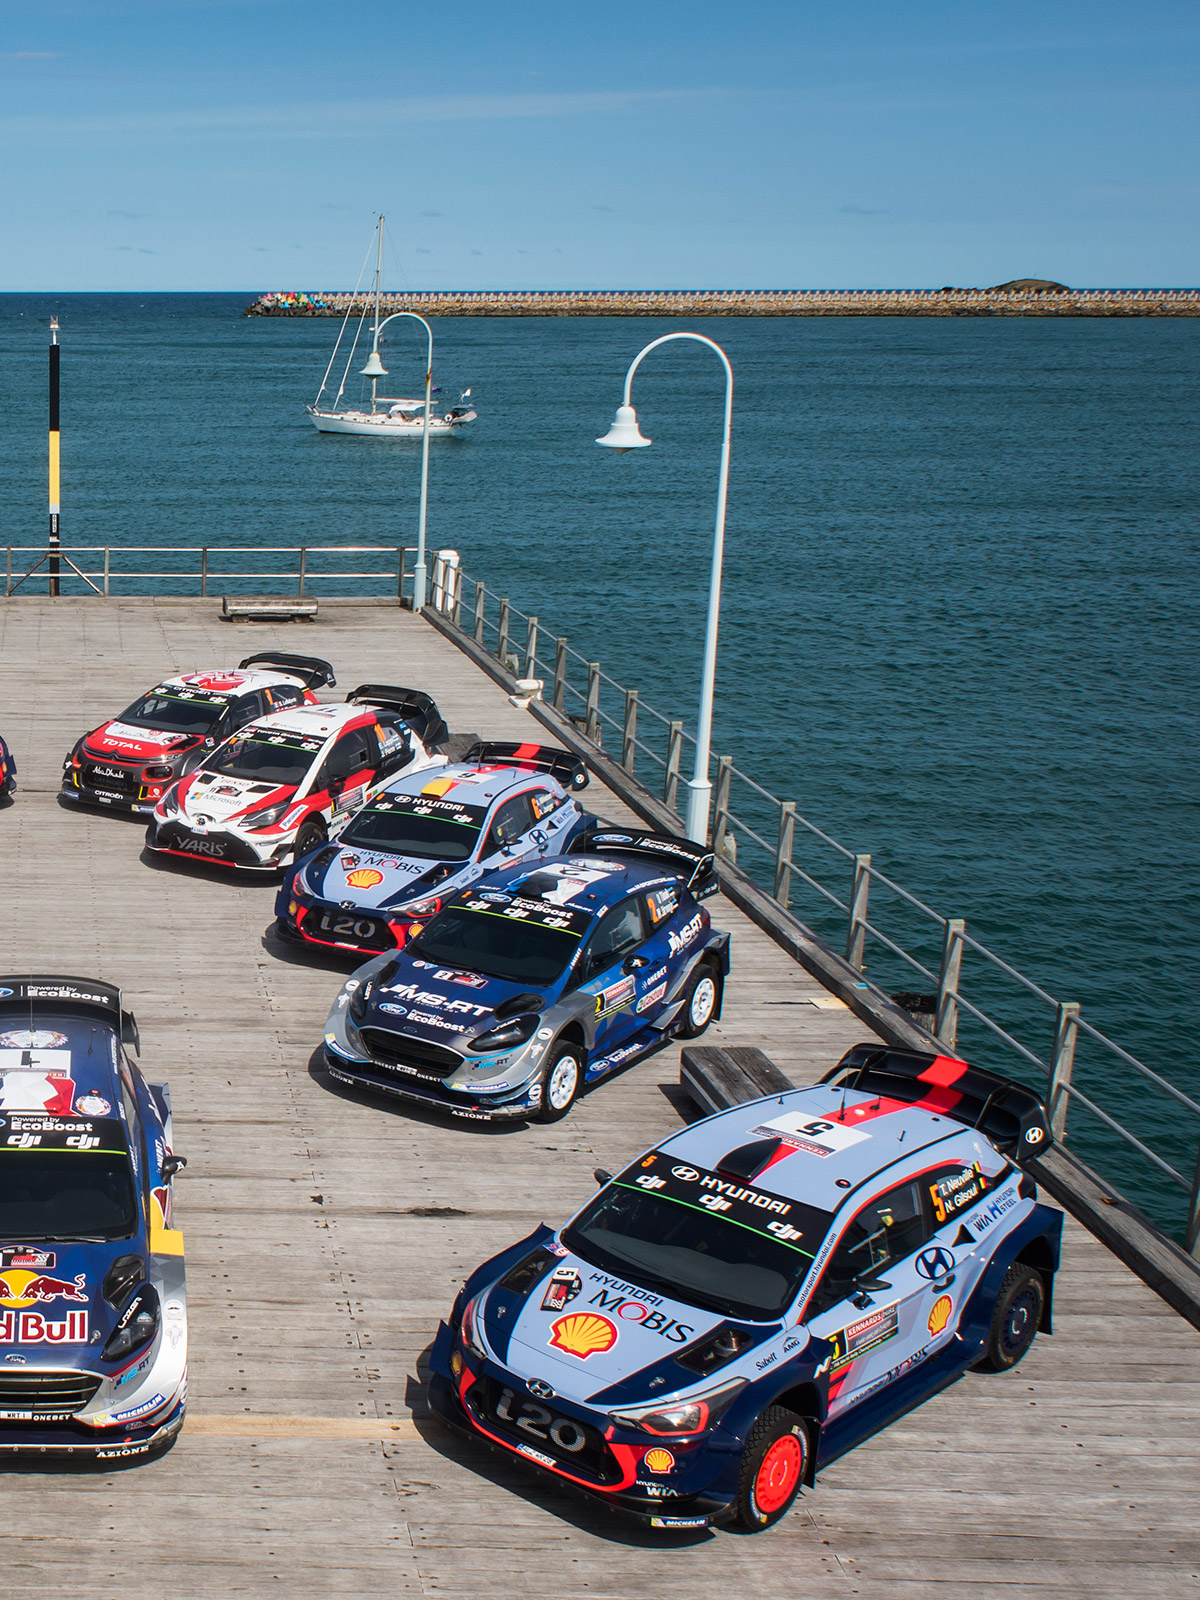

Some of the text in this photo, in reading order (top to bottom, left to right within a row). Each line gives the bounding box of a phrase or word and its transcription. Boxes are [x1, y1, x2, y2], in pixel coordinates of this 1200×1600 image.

[102, 738, 143, 751] TOTAL
[204, 794, 242, 807] Microsoft
[412, 798, 465, 812] HYUNDAI
[360, 850, 404, 861] HYUNDAI
[640, 842, 701, 862] EcoBoost
[364, 857, 425, 875] MOBIS
[511, 900, 574, 919] EcoBoost
[27, 990, 109, 1004] EcoBoost
[406, 1012, 465, 1033] EcoBoost
[411, 1008, 435, 1019] Powered
[468, 1082, 508, 1091] MICHELIN
[12, 1116, 44, 1124] Powered
[46, 1117, 60, 1125] by
[451, 1110, 493, 1121] AZIONE
[11, 1122, 93, 1133] EcoBoost
[796, 1122, 835, 1137] 5
[641, 1155, 658, 1168] 5
[947, 1168, 975, 1193] Neuville
[700, 1176, 792, 1215] HYUNDAI
[929, 1184, 947, 1223] 5
[954, 1182, 979, 1208] Gilsoul
[995, 1187, 1016, 1205] HYUNDAI
[1000, 1198, 1017, 1214] STEEL
[973, 1214, 994, 1233] WIA
[556, 1269, 575, 1277] 5
[798, 1232, 838, 1308] motorsport.hyundai.com
[589, 1272, 664, 1307] HYUNDAI
[588, 1288, 695, 1343] MOBIS
[848, 1312, 882, 1337] KENNARDS
[18, 1310, 89, 1344] Bull
[783, 1340, 800, 1353] AMG
[756, 1352, 778, 1371] Sabelt
[117, 1394, 163, 1420] MICHELIN
[496, 1388, 586, 1452] i20
[97, 1444, 150, 1459] AZIONE
[665, 1518, 706, 1526] MICHELIN
